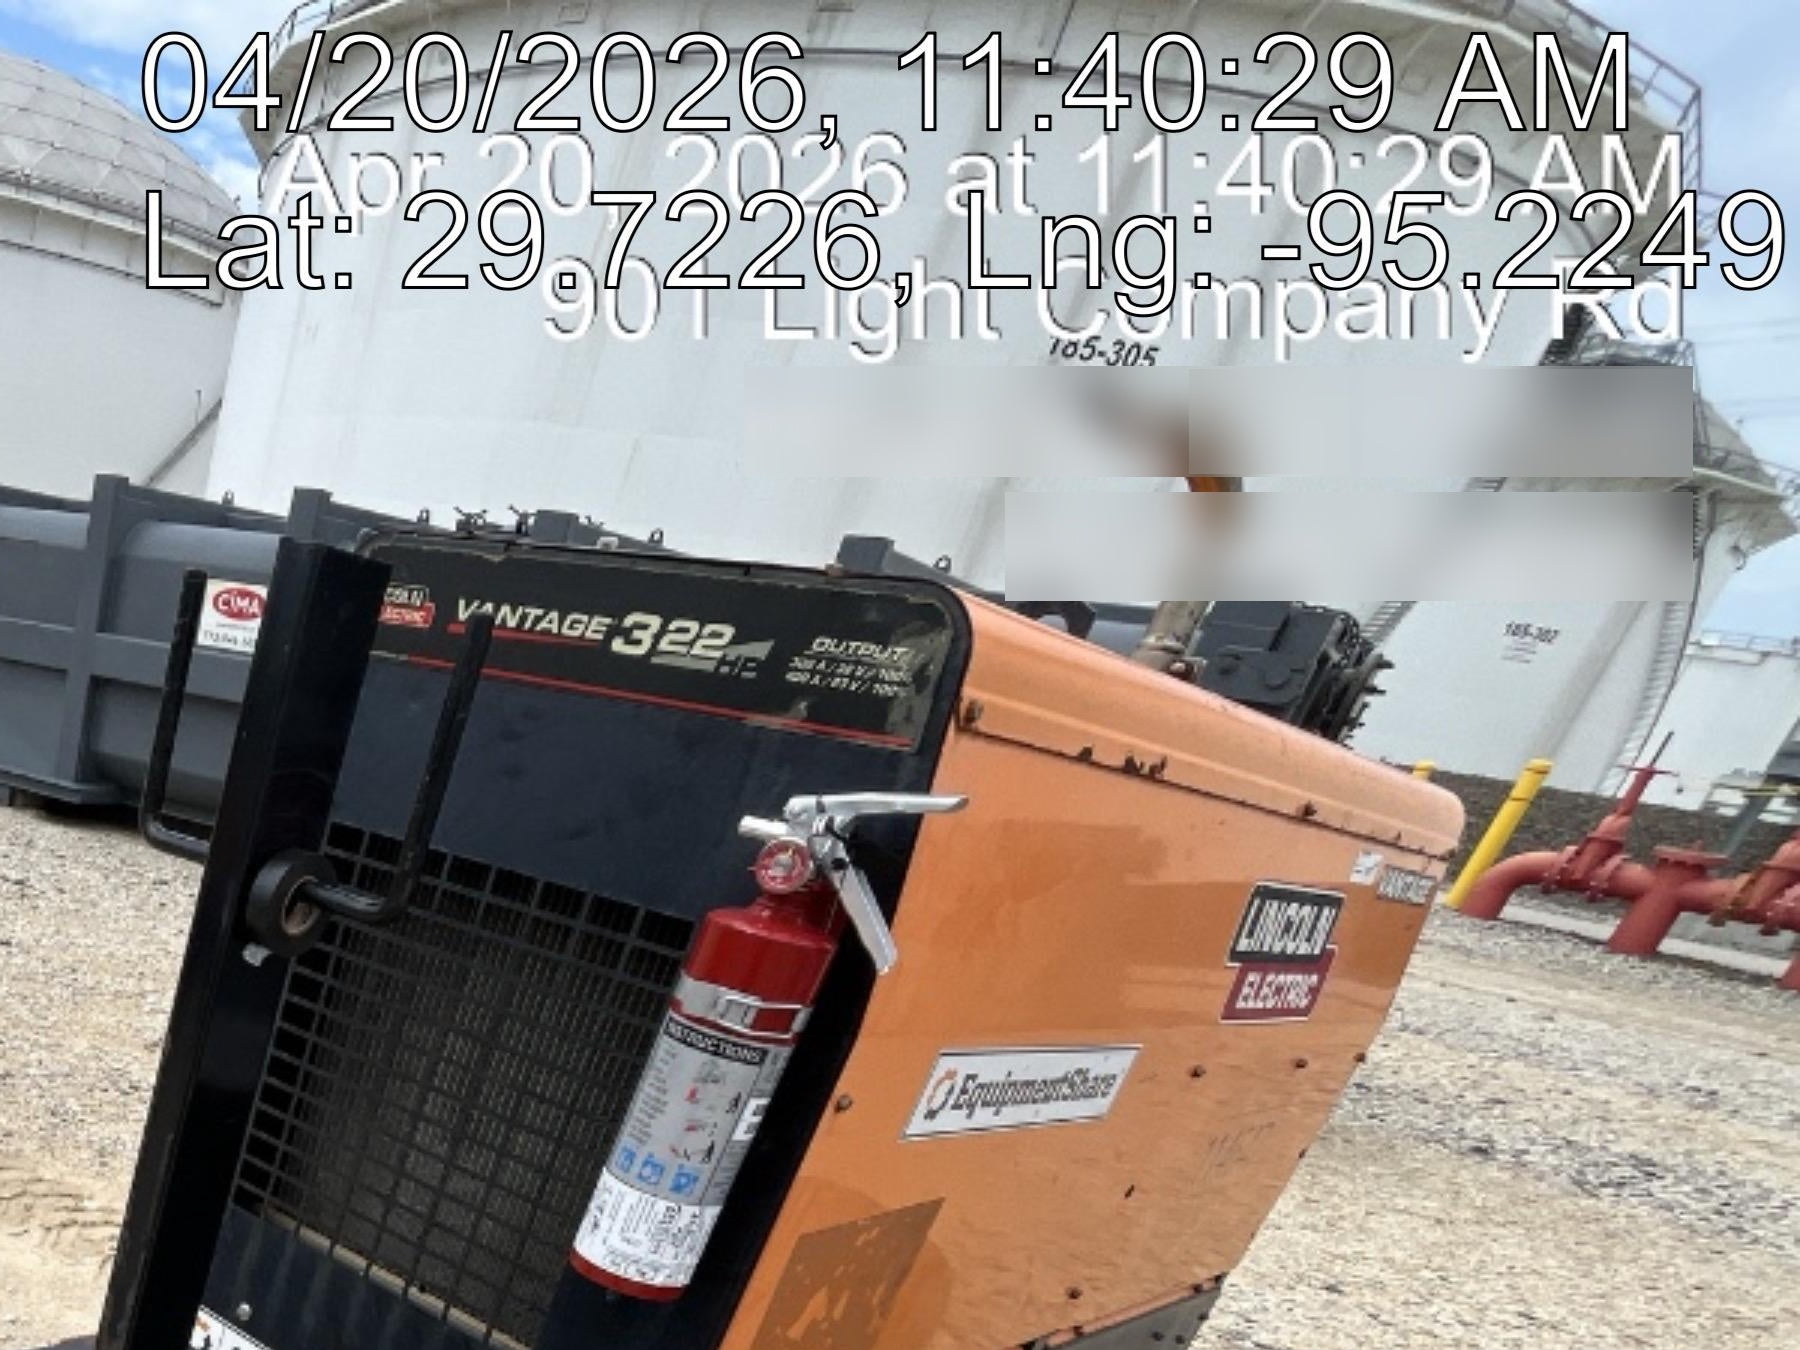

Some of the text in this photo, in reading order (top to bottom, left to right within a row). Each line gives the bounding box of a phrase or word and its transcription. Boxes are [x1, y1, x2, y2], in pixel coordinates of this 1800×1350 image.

[457, 597, 736, 659] VANTAGE 322
[812, 637, 909, 661] OUTPUT
[1235, 899, 1338, 955] LINCOLN
[1236, 972, 1320, 1010] ELECTRIC
[951, 1067, 1118, 1119] EquipmentShare
